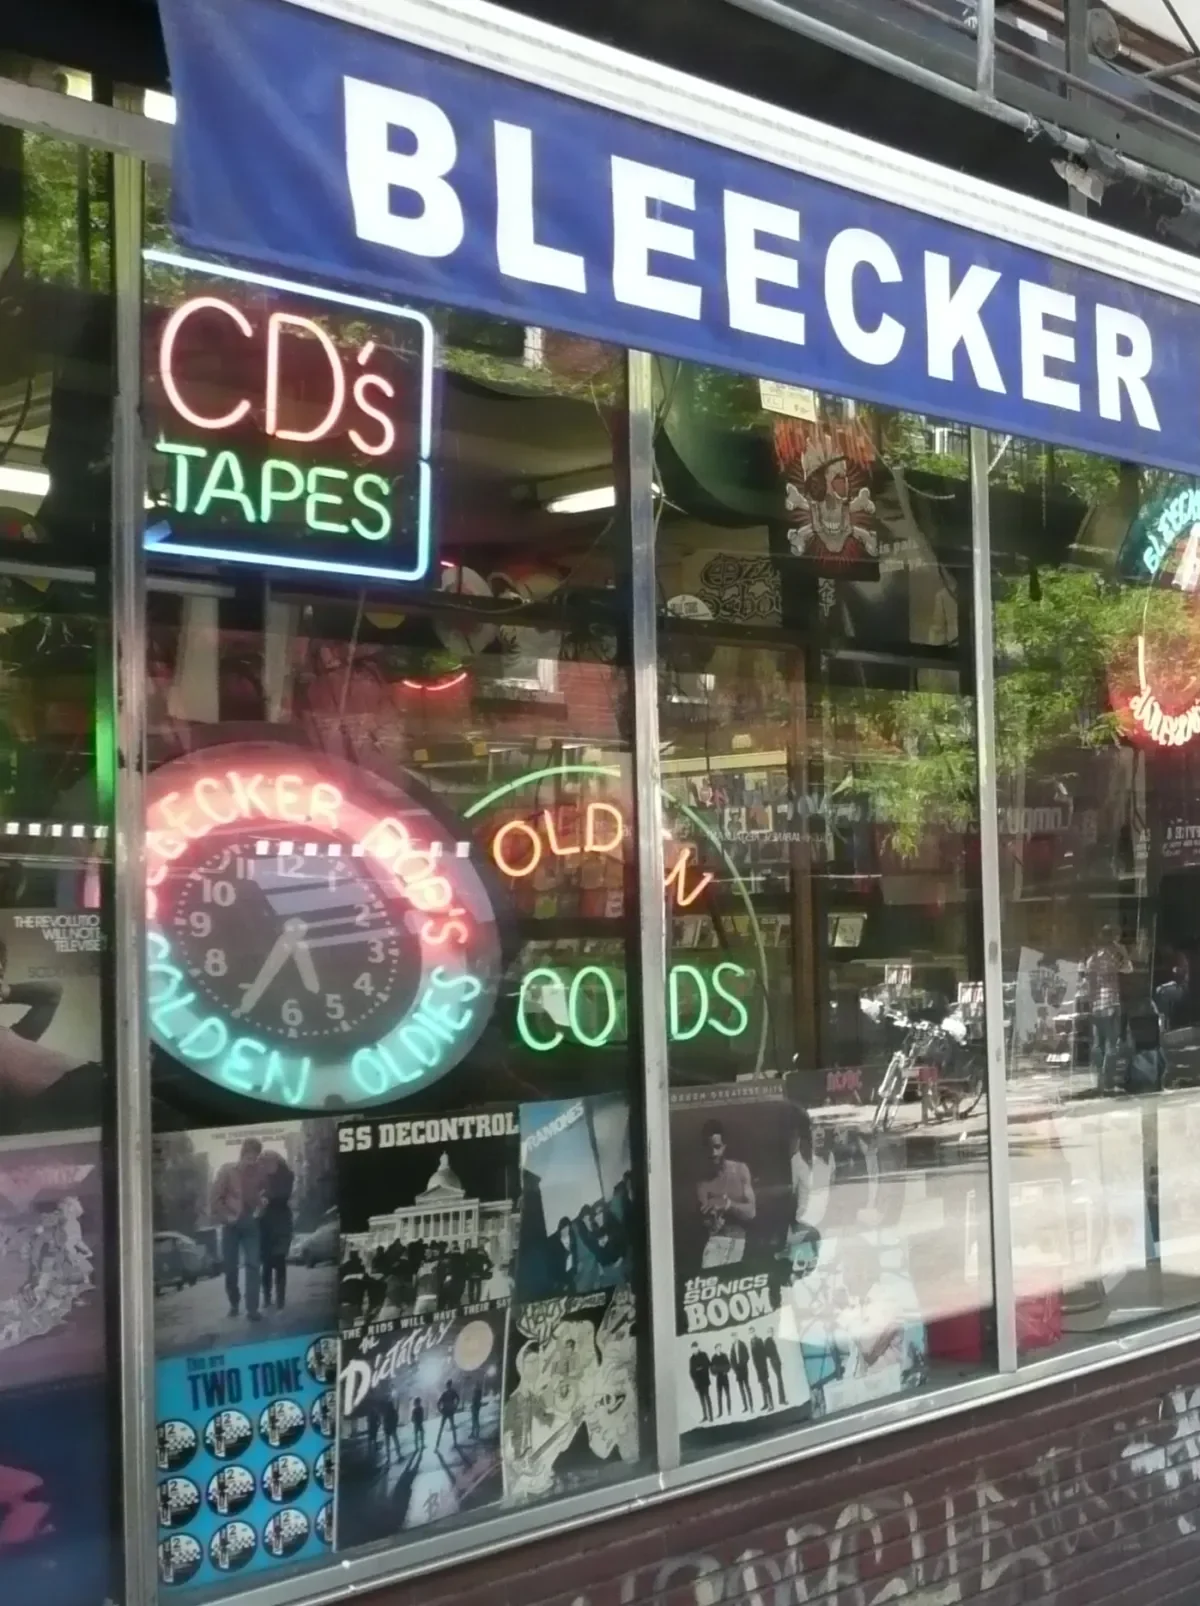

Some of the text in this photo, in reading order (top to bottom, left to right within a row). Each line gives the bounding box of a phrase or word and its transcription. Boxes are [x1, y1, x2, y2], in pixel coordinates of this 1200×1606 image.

[343, 75, 1160, 431] BLEECKER
[155, 442, 392, 540] TAPES
[493, 802, 713, 905] OLDN
[202, 880, 236, 907] 10
[189, 912, 212, 938] 9
[355, 903, 371, 928] 2
[204, 948, 228, 977] 8
[368, 939, 385, 964] 3
[353, 972, 374, 996] 4
[281, 999, 303, 1027] 6
[325, 994, 345, 1020] 5
[351, 966, 482, 1095] OLDIES
[762, 1084, 783, 1094] HITS
[338, 1112, 519, 1152] SS DECONTROL
[527, 1102, 584, 1151] RAMONES
[684, 1273, 769, 1305] SONICS
[685, 1274, 718, 1292] the
[343, 1329, 361, 1340] THE
[401, 1316, 425, 1329] WILL
[463, 1301, 490, 1315] THEIR
[684, 1287, 774, 1332] BOOM
[187, 1356, 303, 1411] TWO TONE
